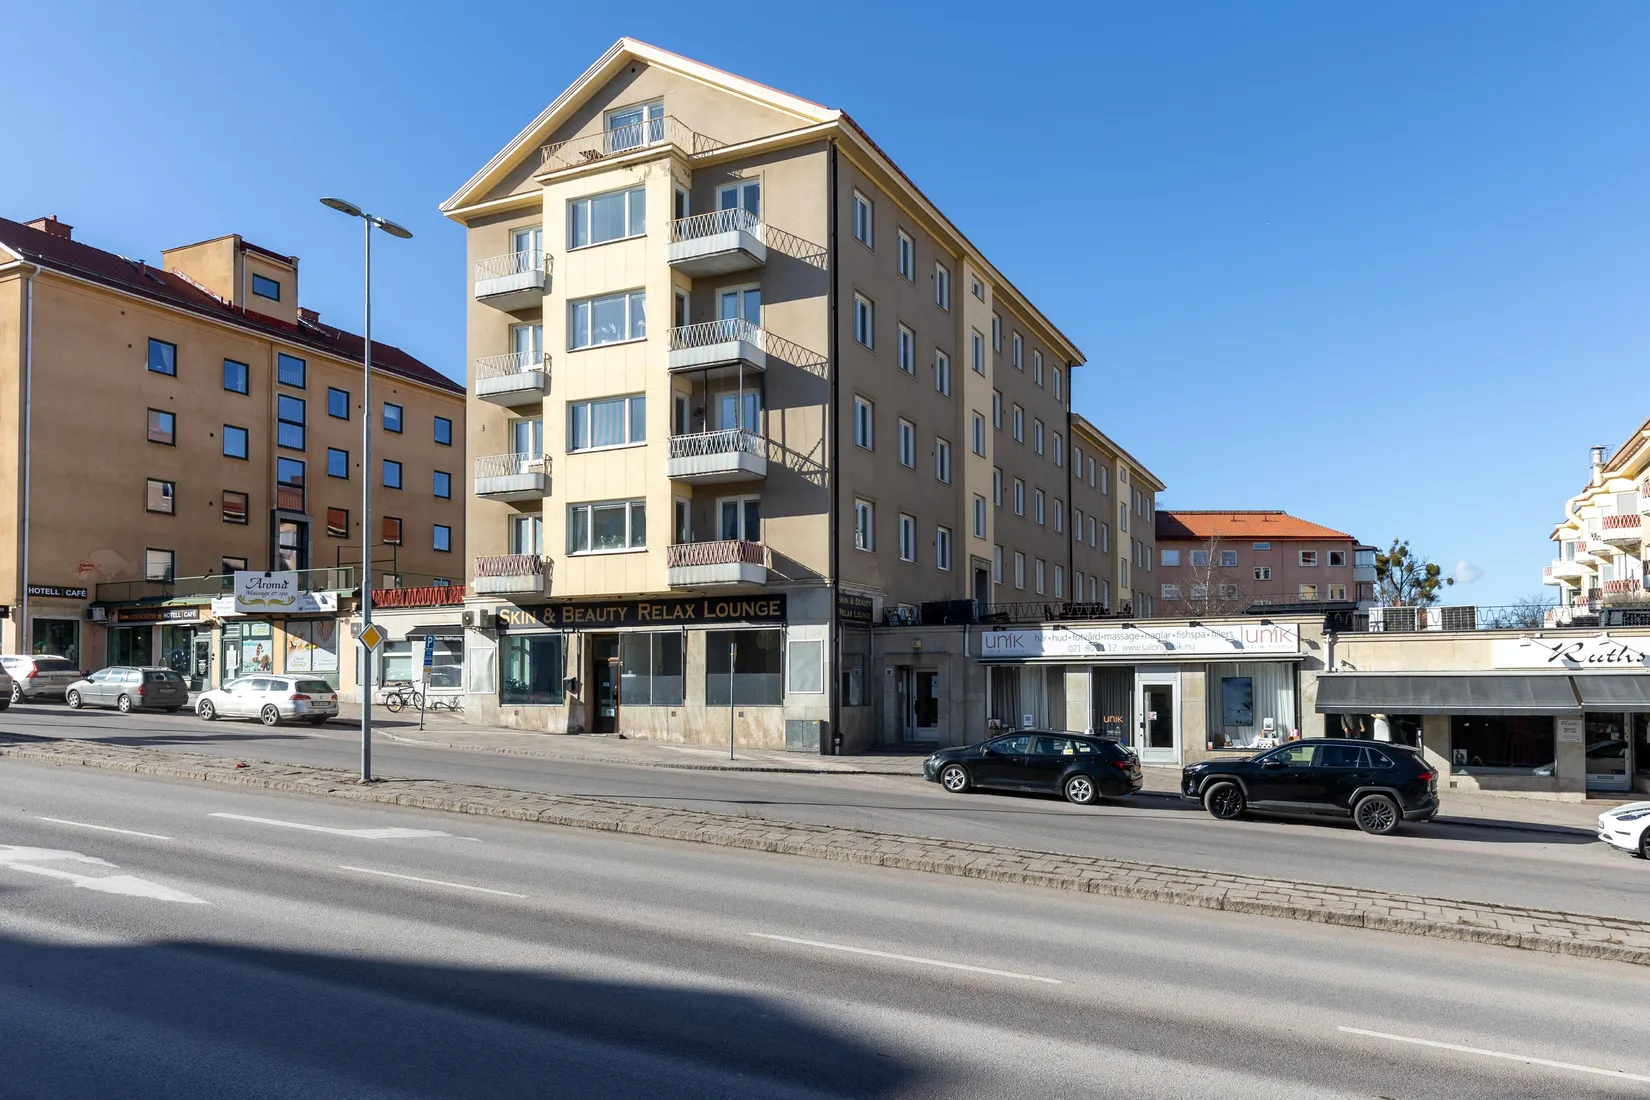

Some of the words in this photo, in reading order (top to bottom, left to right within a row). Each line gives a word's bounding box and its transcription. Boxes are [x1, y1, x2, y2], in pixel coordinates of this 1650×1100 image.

[245, 577, 290, 589] Aroma
[28, 587, 60, 596] HOTELL
[245, 590, 270, 598] Massage
[163, 611, 181, 619] HOTELL
[543, 607, 556, 624] &
[1104, 632, 1140, 642] massage
[1176, 629, 1206, 641] fishspa
[427, 636, 433, 647] P
[1548, 642, 1646, 663] Ruths
[1103, 715, 1124, 723] unik
